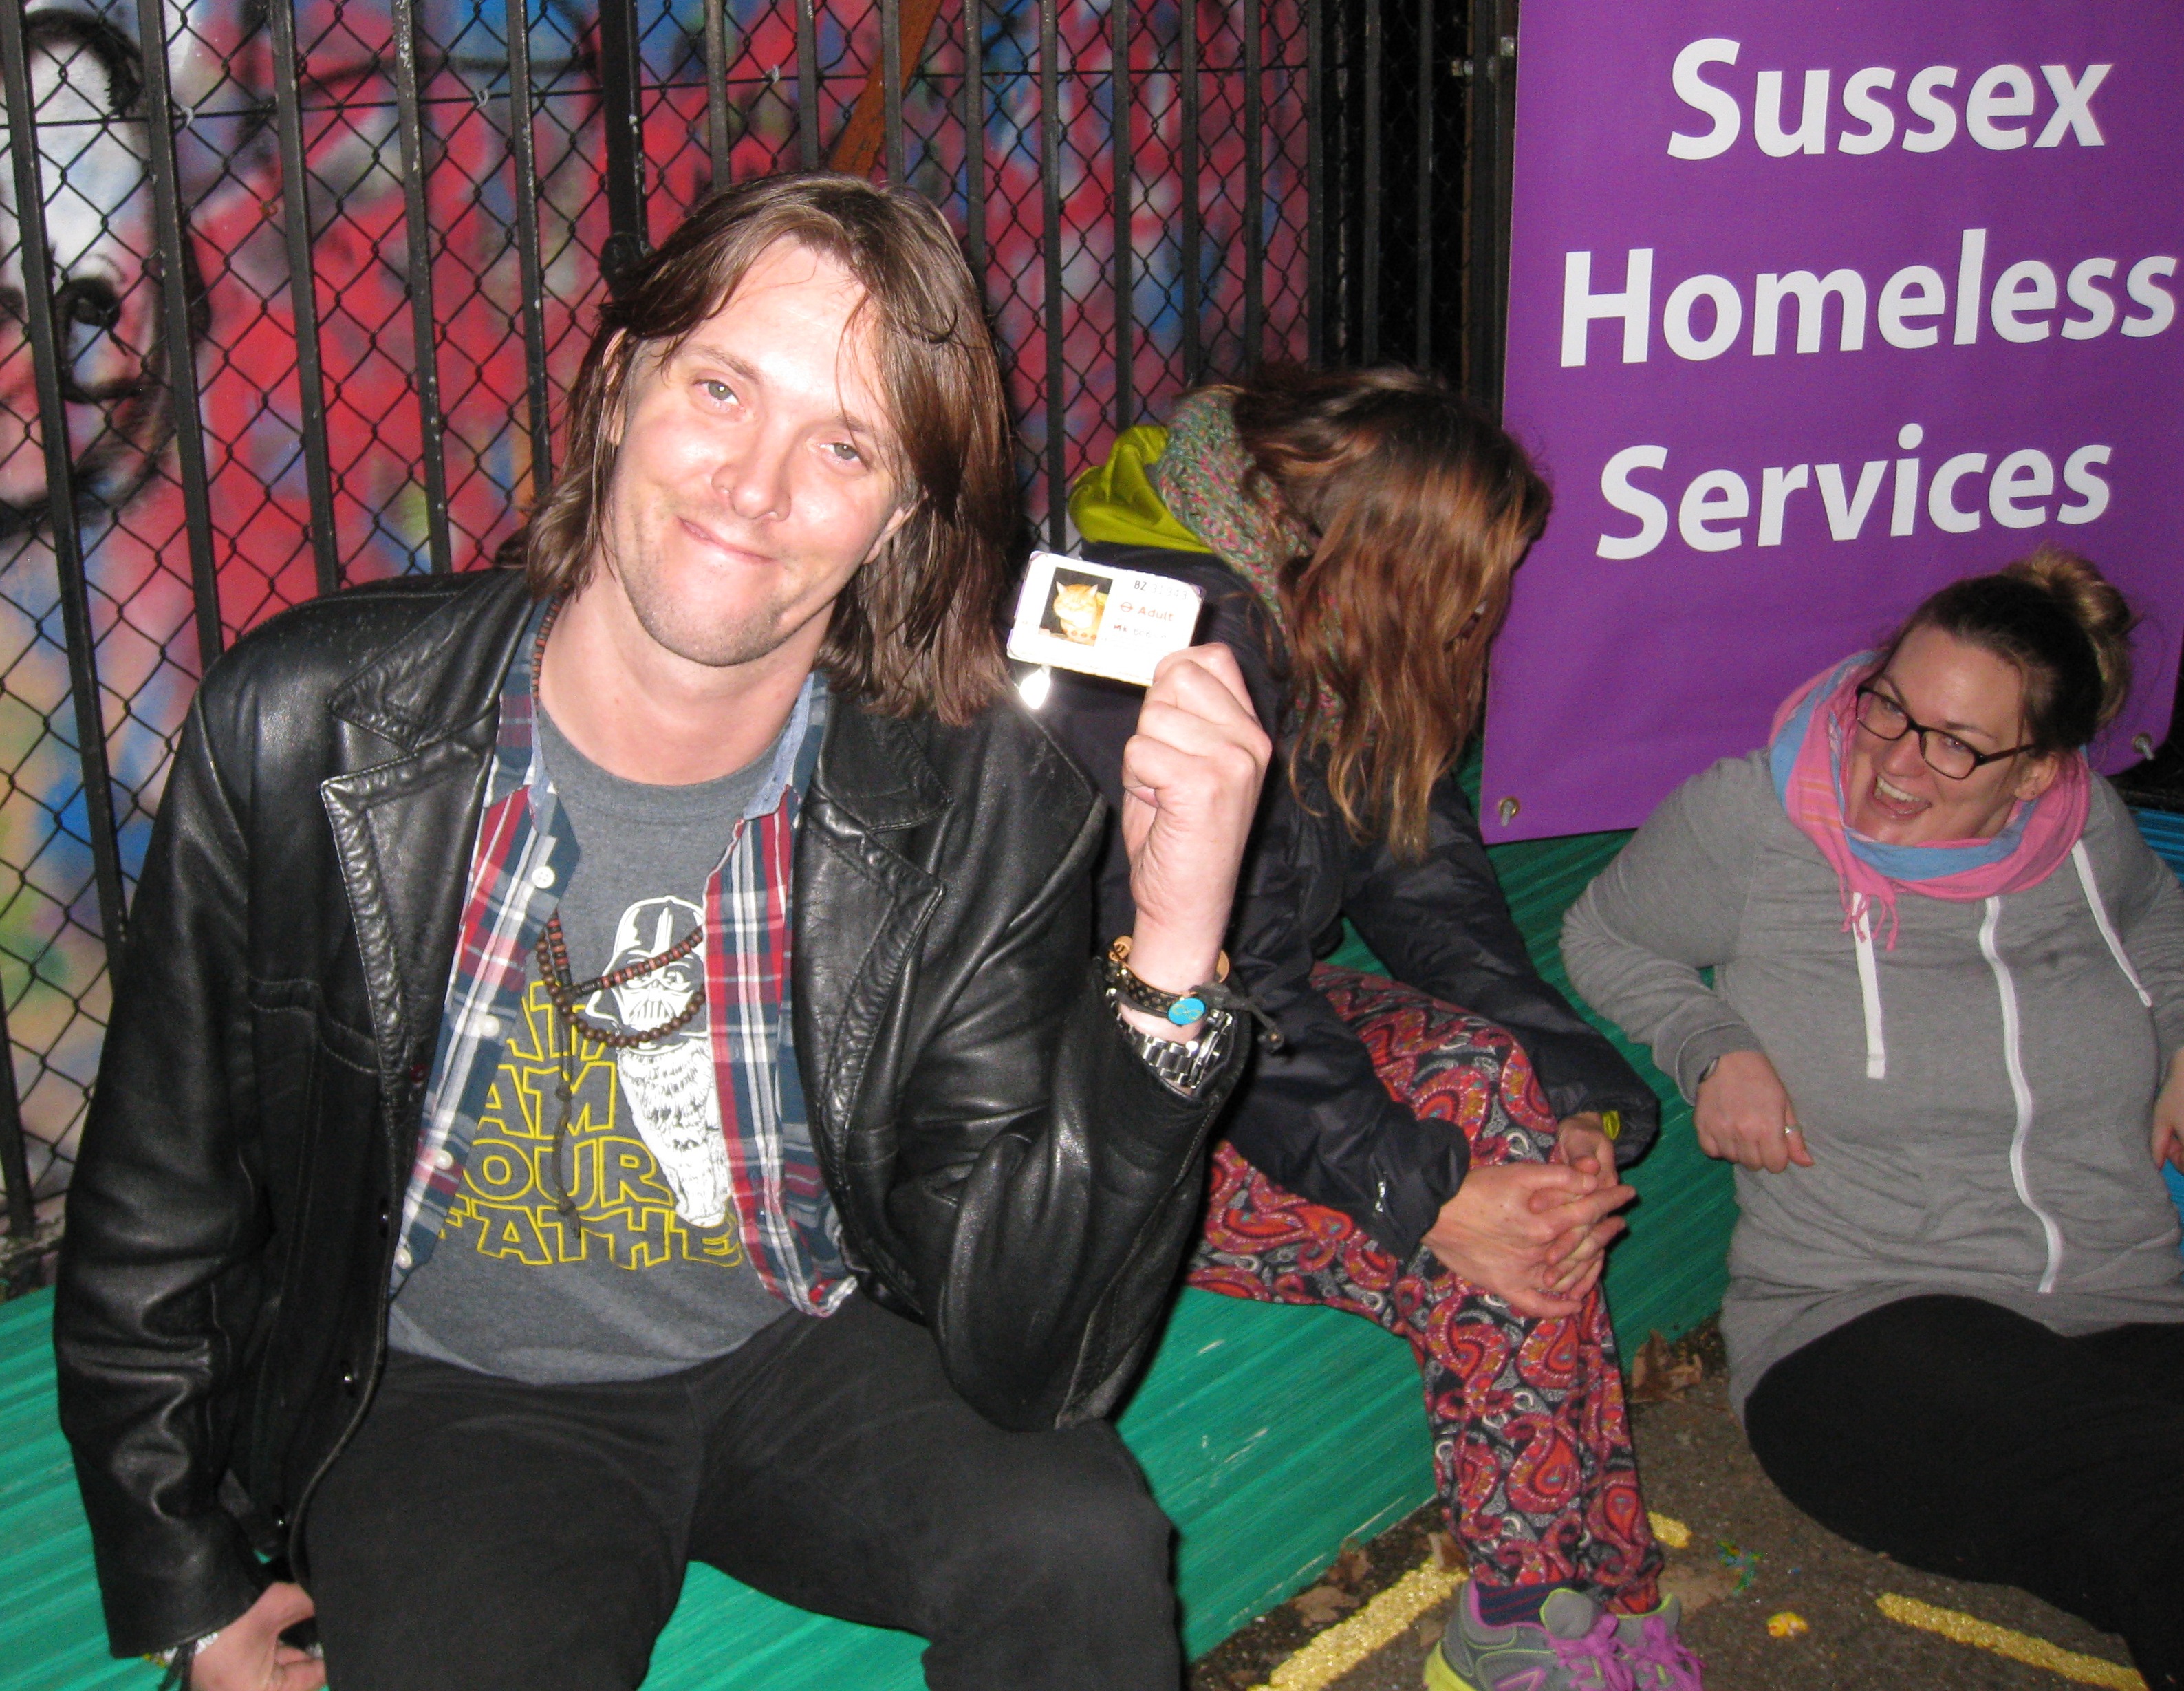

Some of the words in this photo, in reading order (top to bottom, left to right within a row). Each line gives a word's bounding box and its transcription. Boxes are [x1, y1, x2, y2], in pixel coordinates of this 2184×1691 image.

[1667, 38, 2112, 160] Sussex
[1561, 229, 2176, 367] Homeless
[1596, 424, 2110, 559] Services
[1134, 580, 1147, 591] BZ
[1138, 606, 1174, 621] Adult
